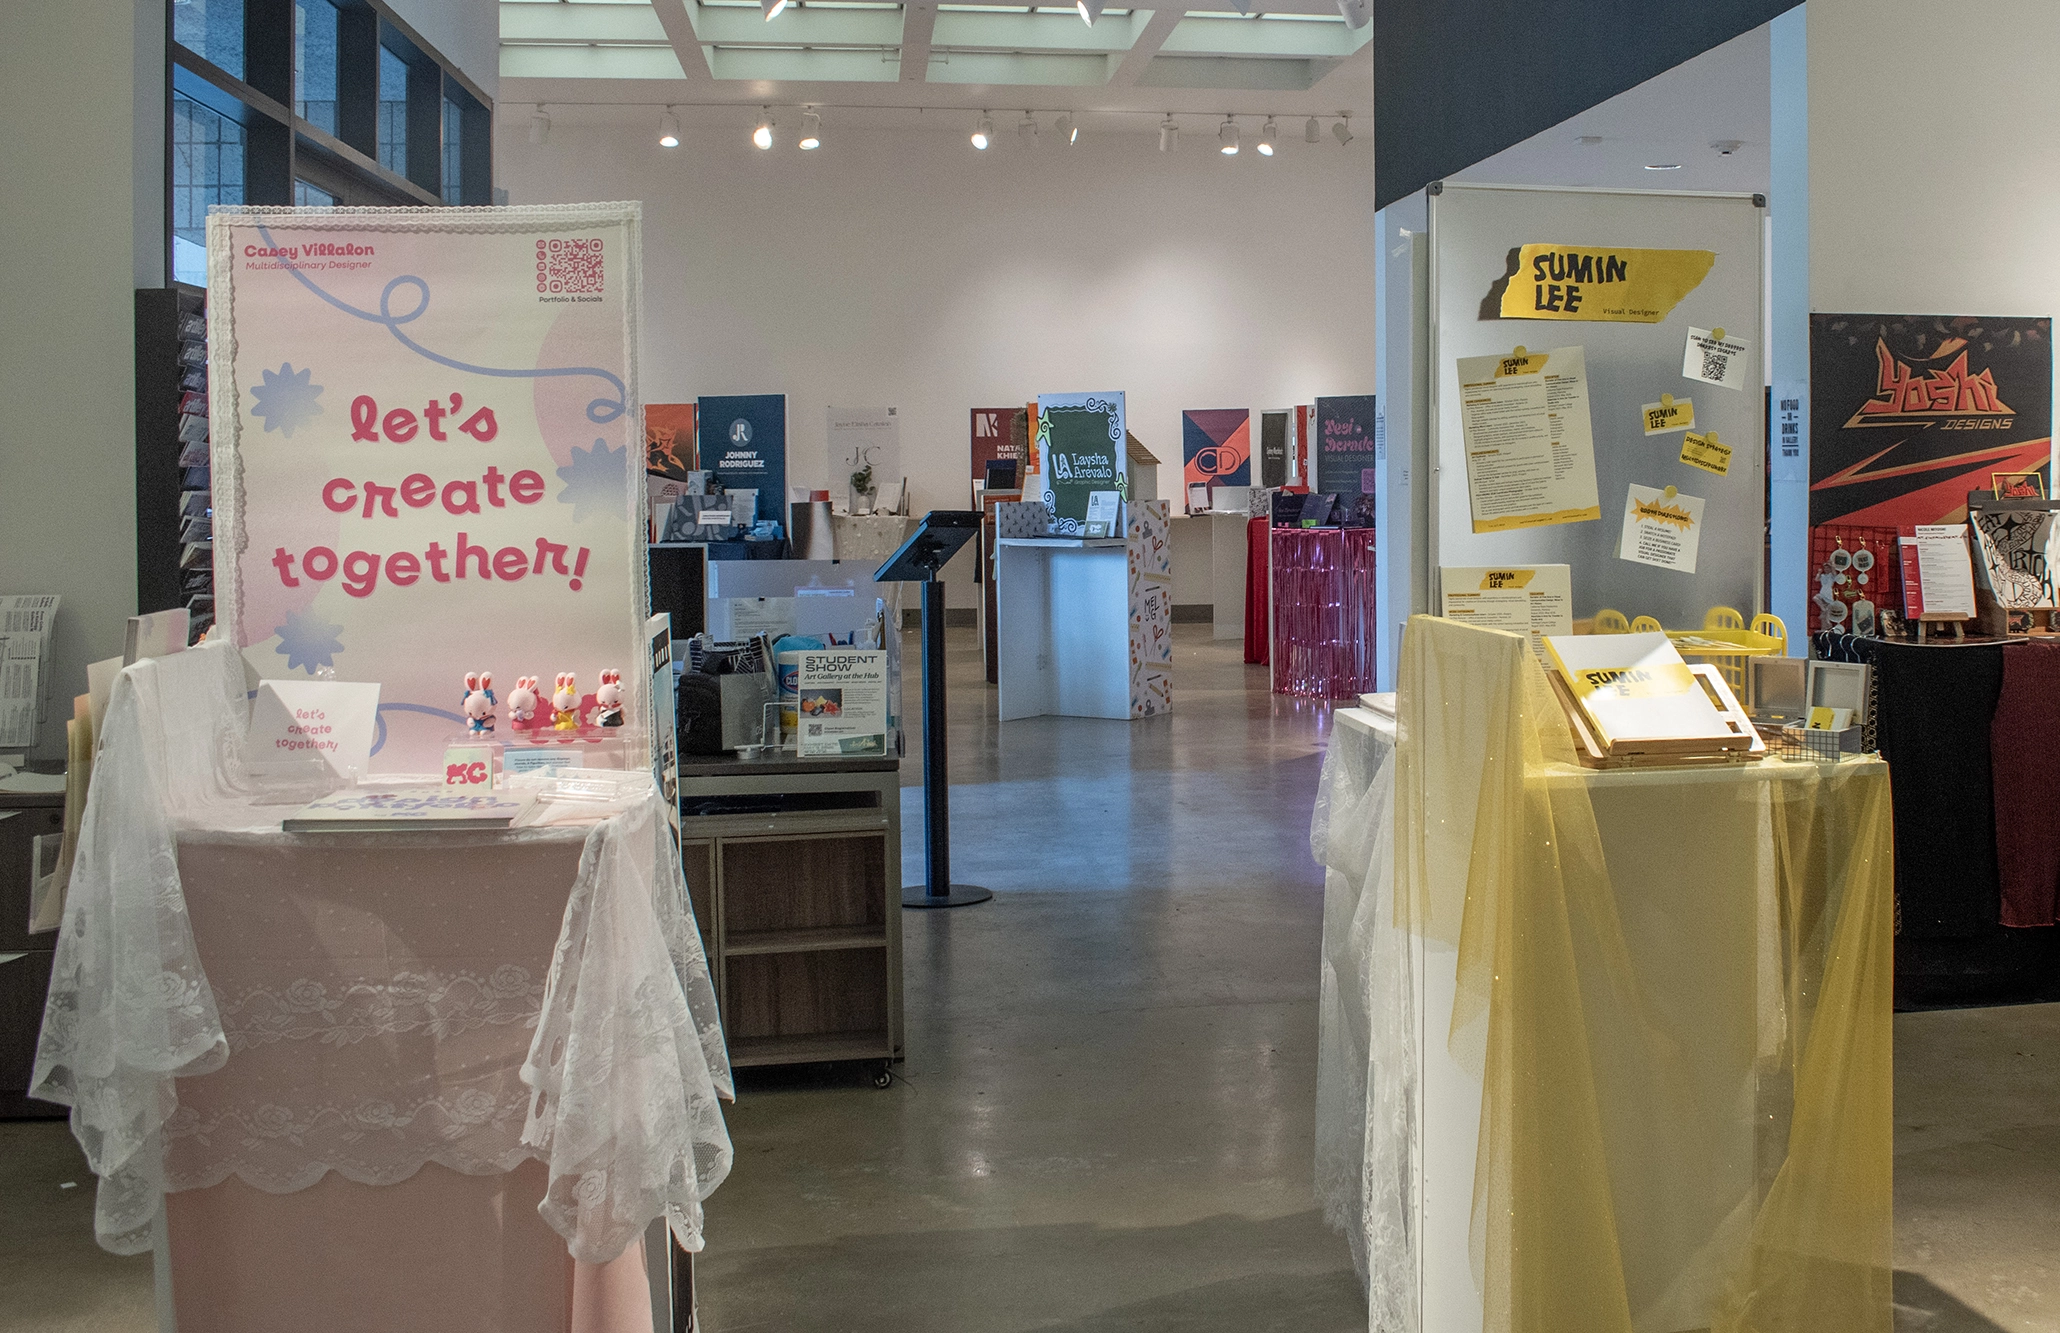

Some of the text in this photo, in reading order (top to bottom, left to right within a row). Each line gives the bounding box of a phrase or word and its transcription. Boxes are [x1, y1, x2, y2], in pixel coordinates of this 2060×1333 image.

[244, 242, 375, 260] Casey Villalon
[245, 260, 372, 272] Multidisciplinary Designer
[1532, 251, 1628, 285] SUMIN
[539, 295, 568, 303] Portfolio
[1533, 284, 1583, 314] LEE
[1602, 307, 1660, 318] Visual Designer
[1502, 357, 1529, 369] SUMIN
[1504, 367, 1518, 375] LEE
[1787, 399, 1799, 411] FOOD
[351, 392, 499, 443] let's
[1648, 407, 1678, 421] SUMIN
[1650, 419, 1666, 429] LEE
[1782, 423, 1798, 434] DRINKS
[1941, 418, 2014, 430] DESIGNS
[725, 451, 758, 459] JOHNNY
[1072, 452, 1109, 468] Laysha
[719, 459, 765, 468] RODRIGUEZ
[1073, 465, 1113, 479] Arevalo
[322, 466, 545, 519] create
[272, 532, 590, 598] together!
[1489, 572, 1515, 581] SUMIN
[1489, 580, 1503, 588] LEE
[805, 656, 878, 664] STUDENT
[805, 663, 852, 672] SHOW
[786, 677, 799, 685] CLO
[1586, 670, 1652, 684] SUMIN
[296, 708, 326, 720] let's
[287, 725, 332, 735] create
[275, 737, 339, 753] together!
